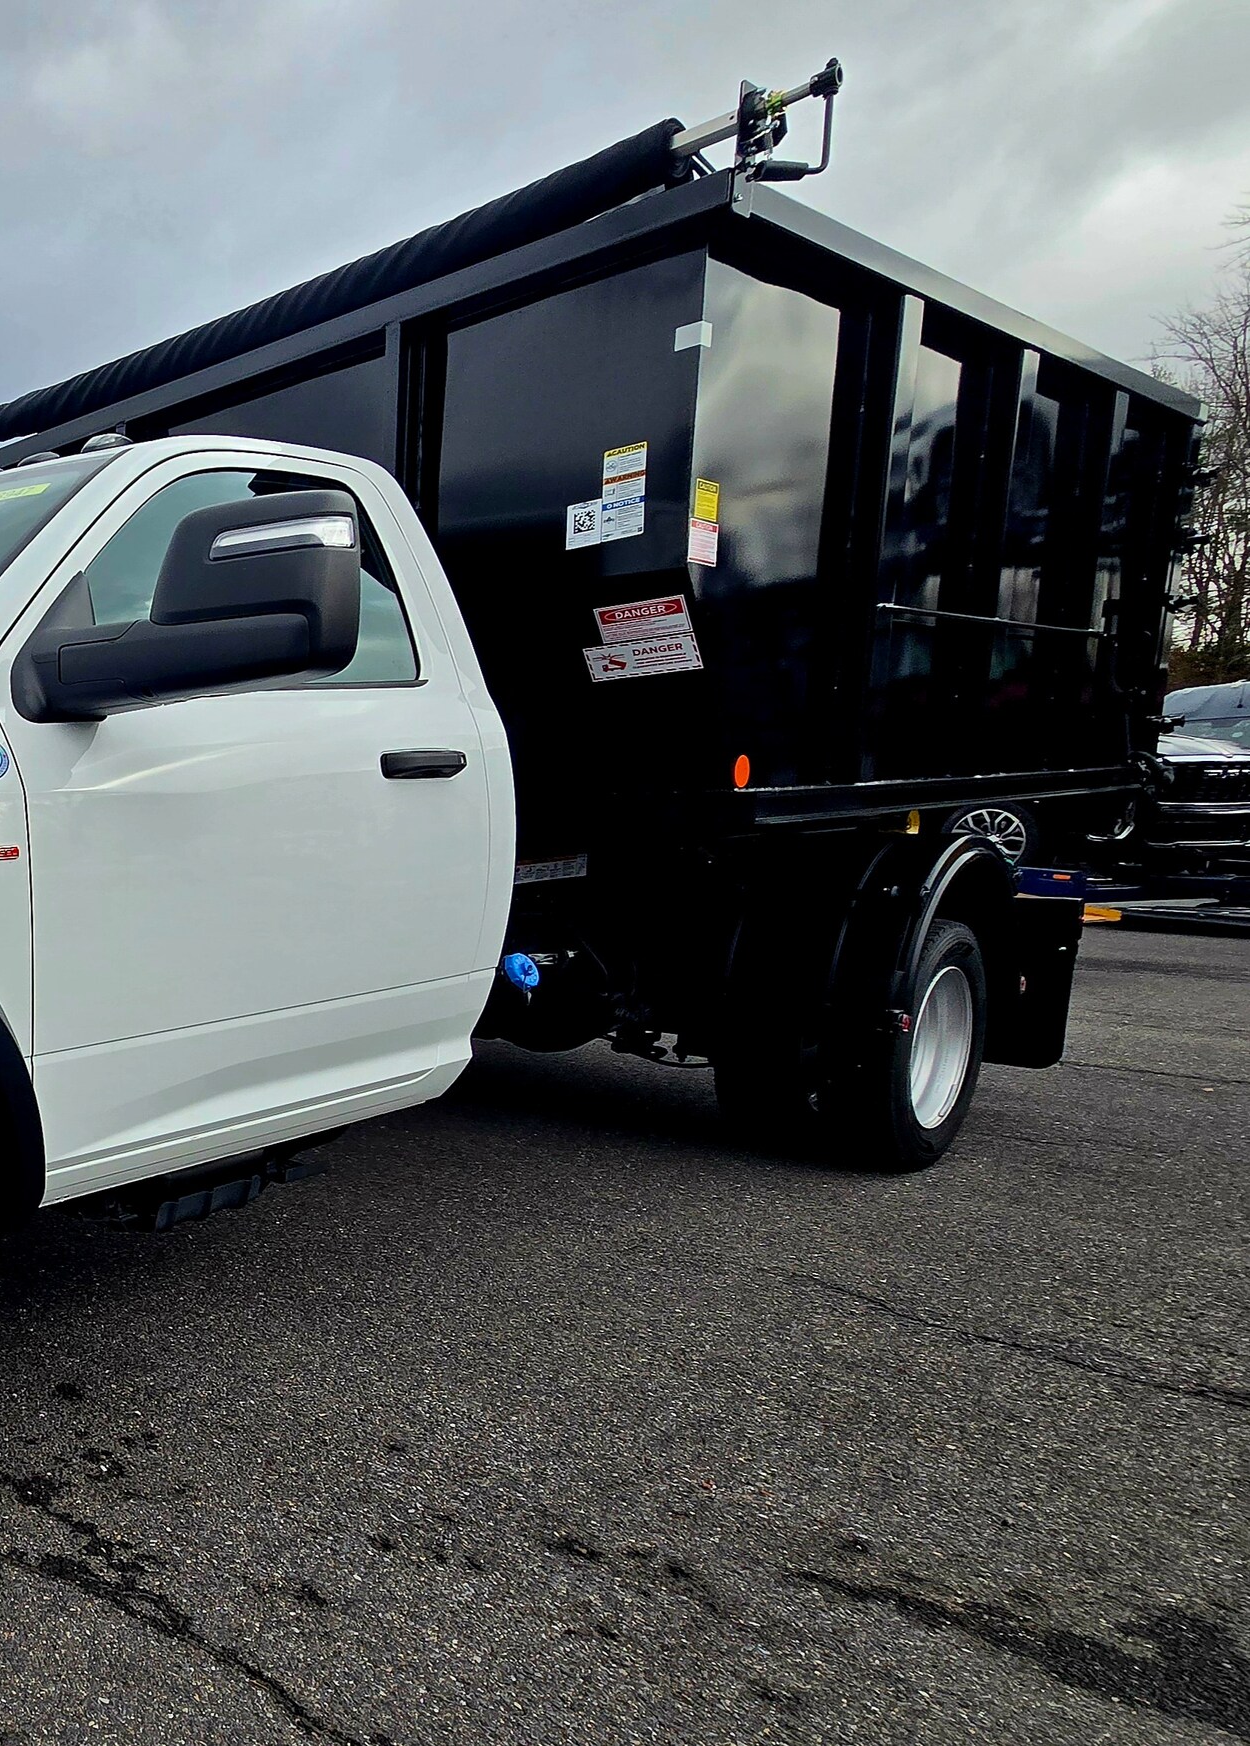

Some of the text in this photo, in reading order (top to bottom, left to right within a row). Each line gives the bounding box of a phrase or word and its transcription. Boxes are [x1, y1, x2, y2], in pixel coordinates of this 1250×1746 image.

[612, 443, 645, 456] CAUTION
[613, 497, 640, 507] NOTICE
[614, 605, 666, 620] DANGER
[632, 642, 683, 656] DANGER
